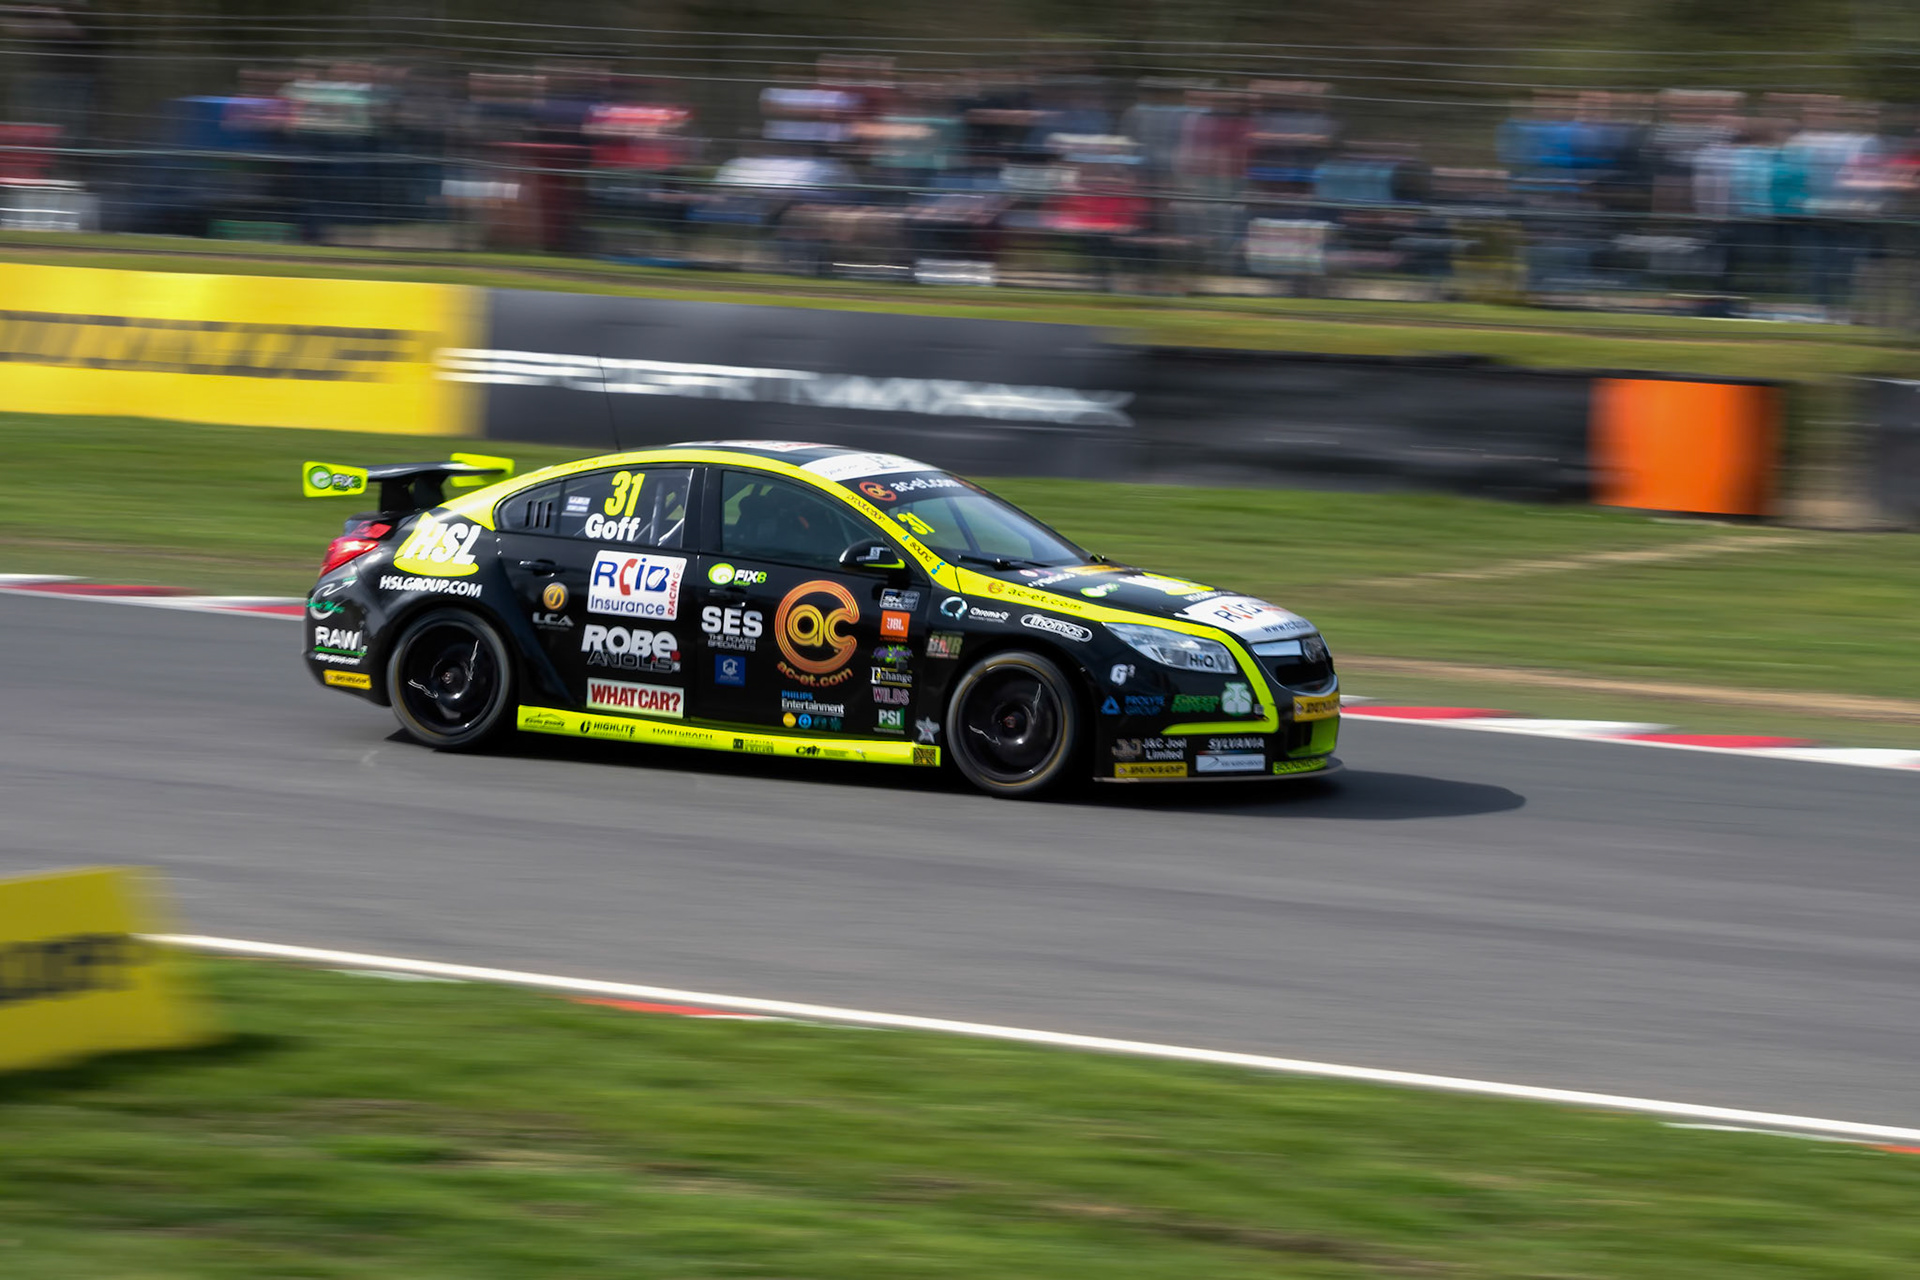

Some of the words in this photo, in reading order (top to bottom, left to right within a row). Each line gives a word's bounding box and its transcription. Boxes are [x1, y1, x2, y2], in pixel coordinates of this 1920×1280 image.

[604, 471, 645, 517] 31
[585, 513, 641, 541] Goff
[897, 512, 935, 535] 31
[403, 518, 482, 566] HSL
[380, 575, 482, 598] HSLGROUP.COM
[667, 572, 680, 617] RACING
[591, 595, 665, 616] Insurance
[701, 606, 763, 638] SES
[886, 617, 904, 631] JBL
[315, 626, 362, 651] RAW
[776, 661, 854, 688] ac-et.com
[591, 684, 638, 708] WHAT
[638, 688, 681, 712] CAR?
[782, 698, 845, 714] Entertainment
[879, 708, 901, 726] PSI
[1145, 750, 1184, 760] Limited
